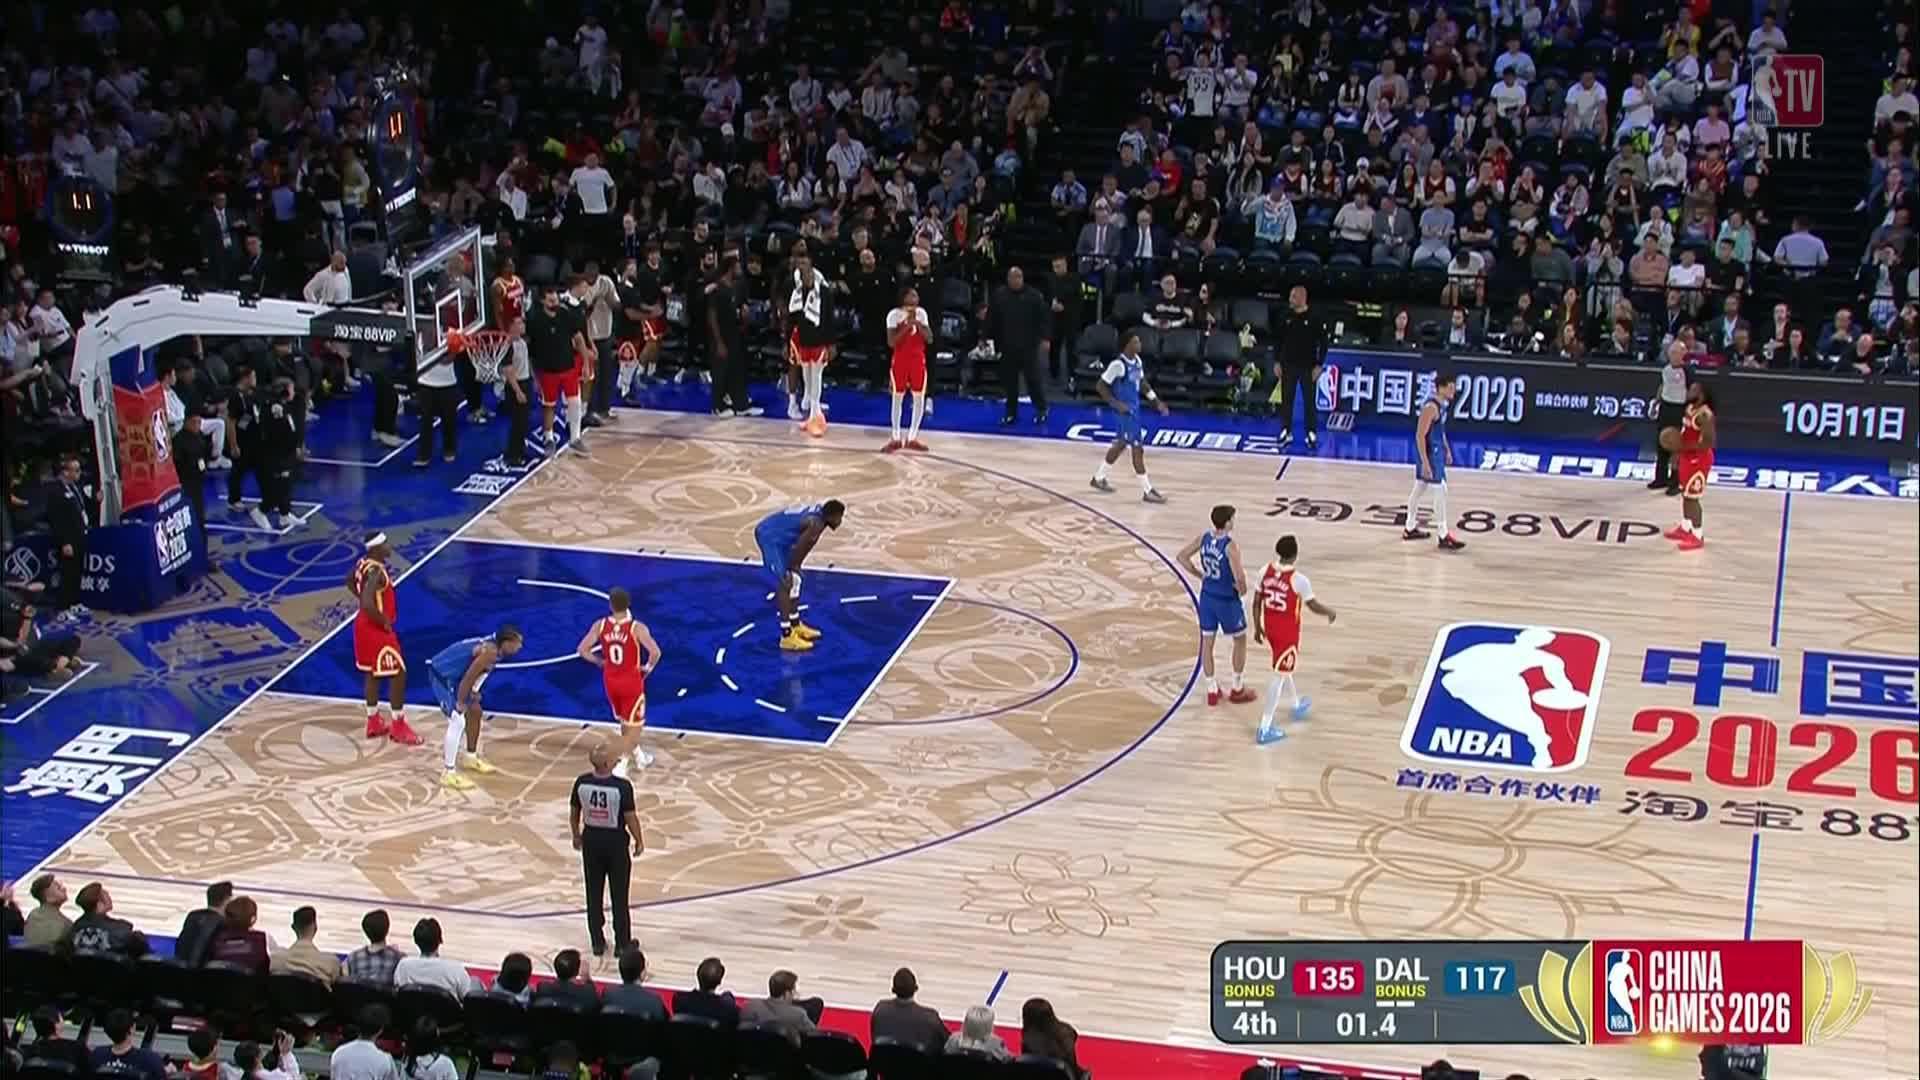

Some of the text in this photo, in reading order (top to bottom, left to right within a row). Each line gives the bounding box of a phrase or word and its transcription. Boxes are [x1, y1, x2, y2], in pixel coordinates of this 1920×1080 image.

[1454, 375, 1525, 422] 2026
[1782, 402, 1904, 440] 10月11日
[1152, 429, 1280, 454] 阿里云
[47, 551, 116, 574] SDS
[1203, 557, 1221, 579] 55
[1263, 589, 1287, 612] 25
[610, 644, 623, 665] 0
[1430, 727, 1513, 760] NBA
[4, 724, 191, 803] 澳門
[590, 790, 607, 808] 43
[1395, 769, 1600, 805] 首席合作伙伴
